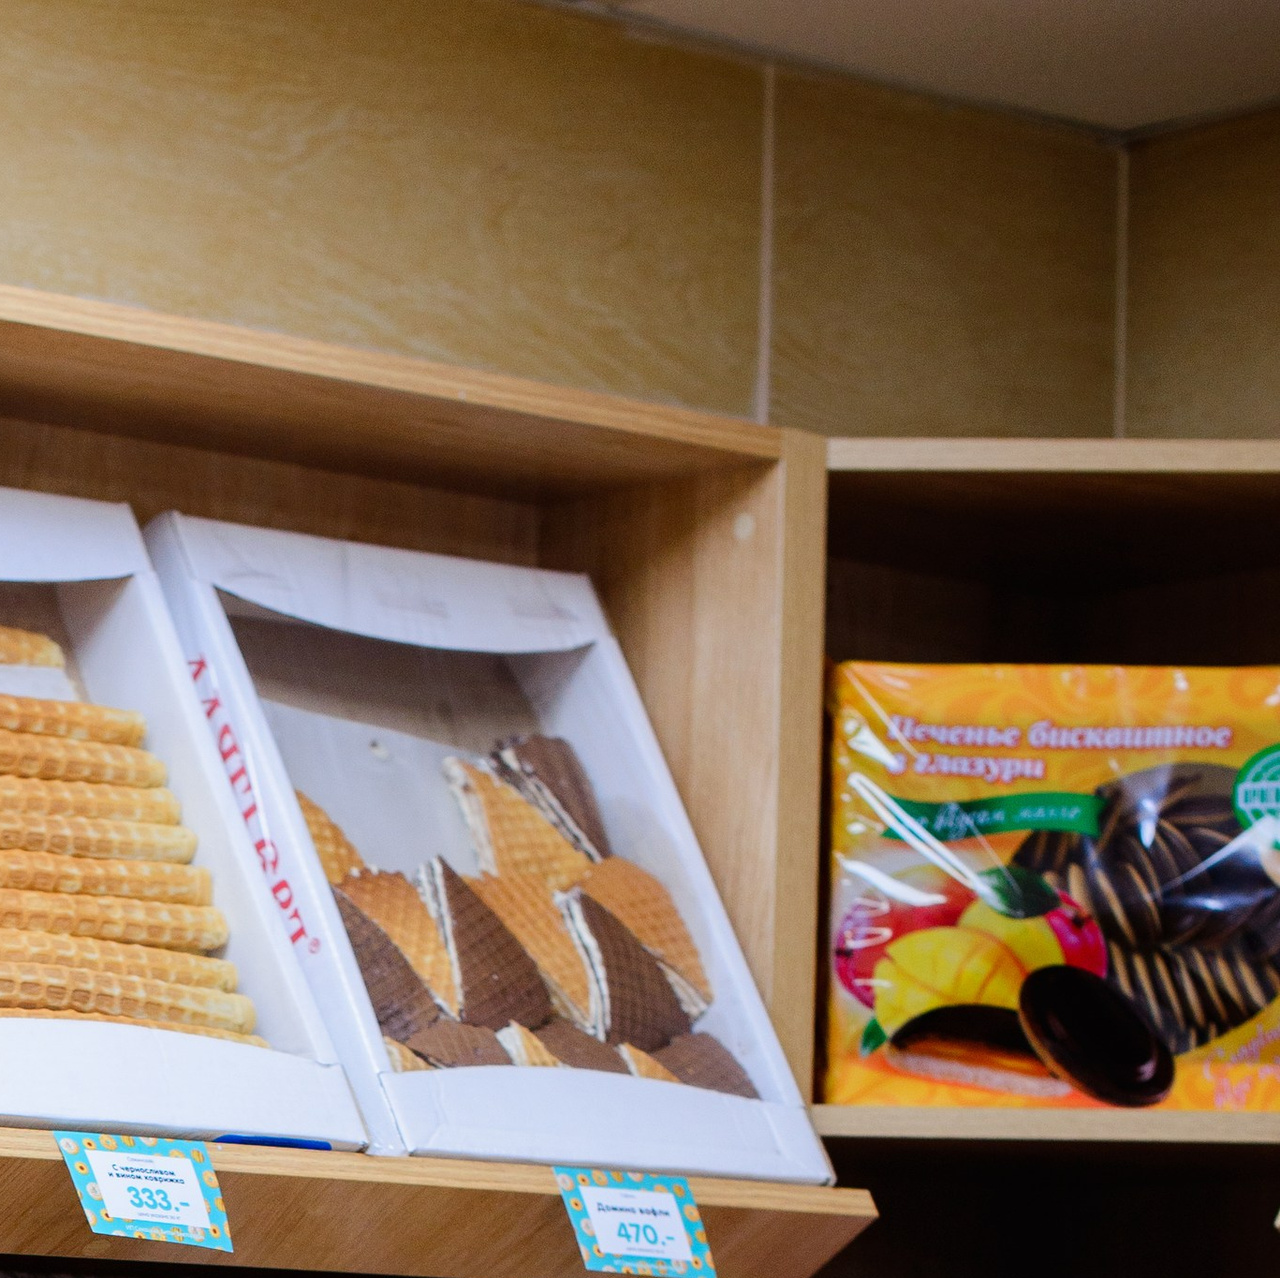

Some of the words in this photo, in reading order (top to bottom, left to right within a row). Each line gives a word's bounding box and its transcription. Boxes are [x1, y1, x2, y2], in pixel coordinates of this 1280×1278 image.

[120, 1166, 176, 1177] черносливом
[144, 1175, 185, 1185] коврижка
[597, 1202, 636, 1214] Домино
